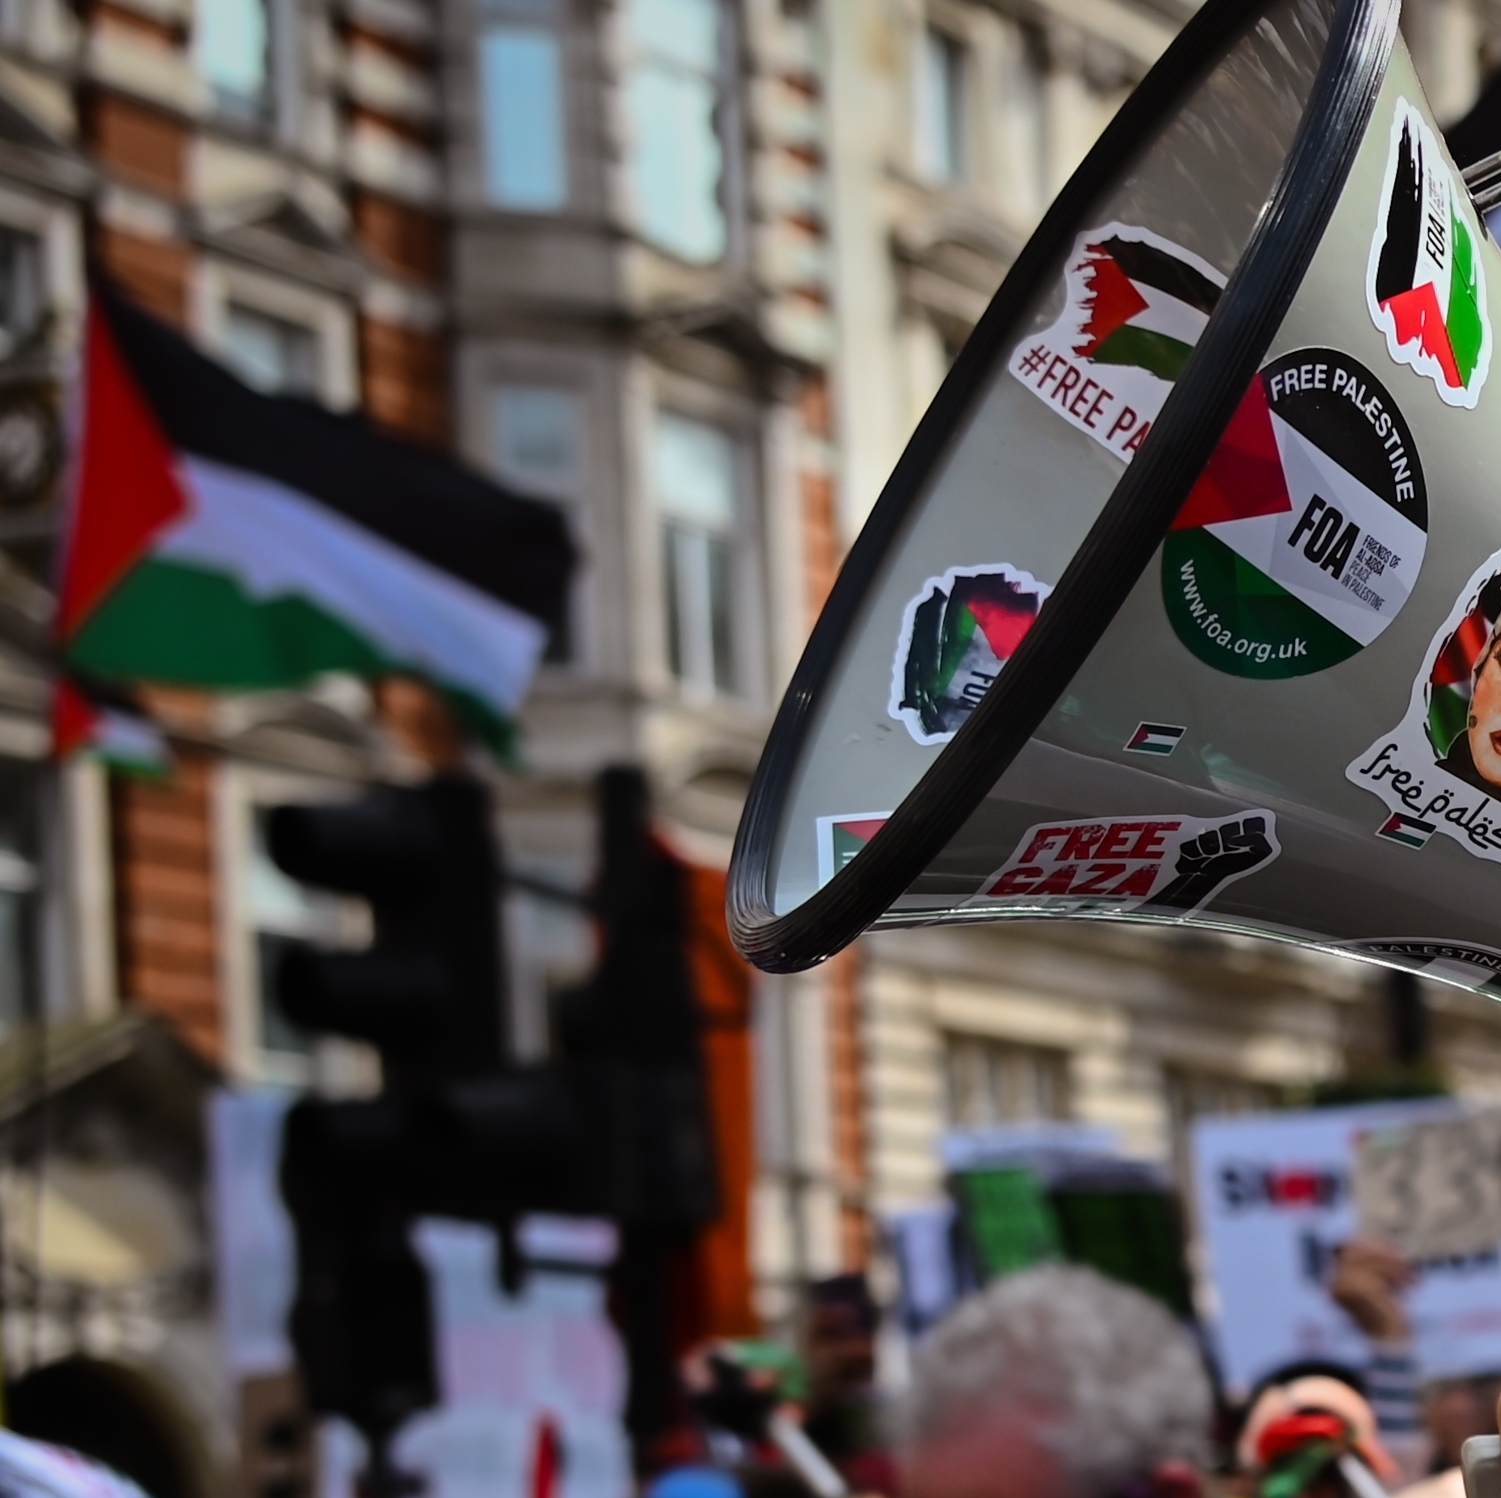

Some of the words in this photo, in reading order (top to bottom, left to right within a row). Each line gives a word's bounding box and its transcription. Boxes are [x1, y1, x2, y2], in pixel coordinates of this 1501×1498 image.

[1426, 212, 1446, 270] FOA
[1018, 344, 1115, 429] #FREE
[1270, 363, 1328, 402] FREE
[1332, 367, 1415, 503] PALESTINE
[1287, 493, 1361, 581] FOA
[1363, 534, 1392, 564] FRIENDS
[1180, 559, 1308, 663] www.foa.org.uk
[1349, 577, 1386, 611] PALESTINE
[1360, 744, 1424, 813] free
[1018, 821, 1182, 863] FREE
[986, 863, 1162, 898] GAZA
